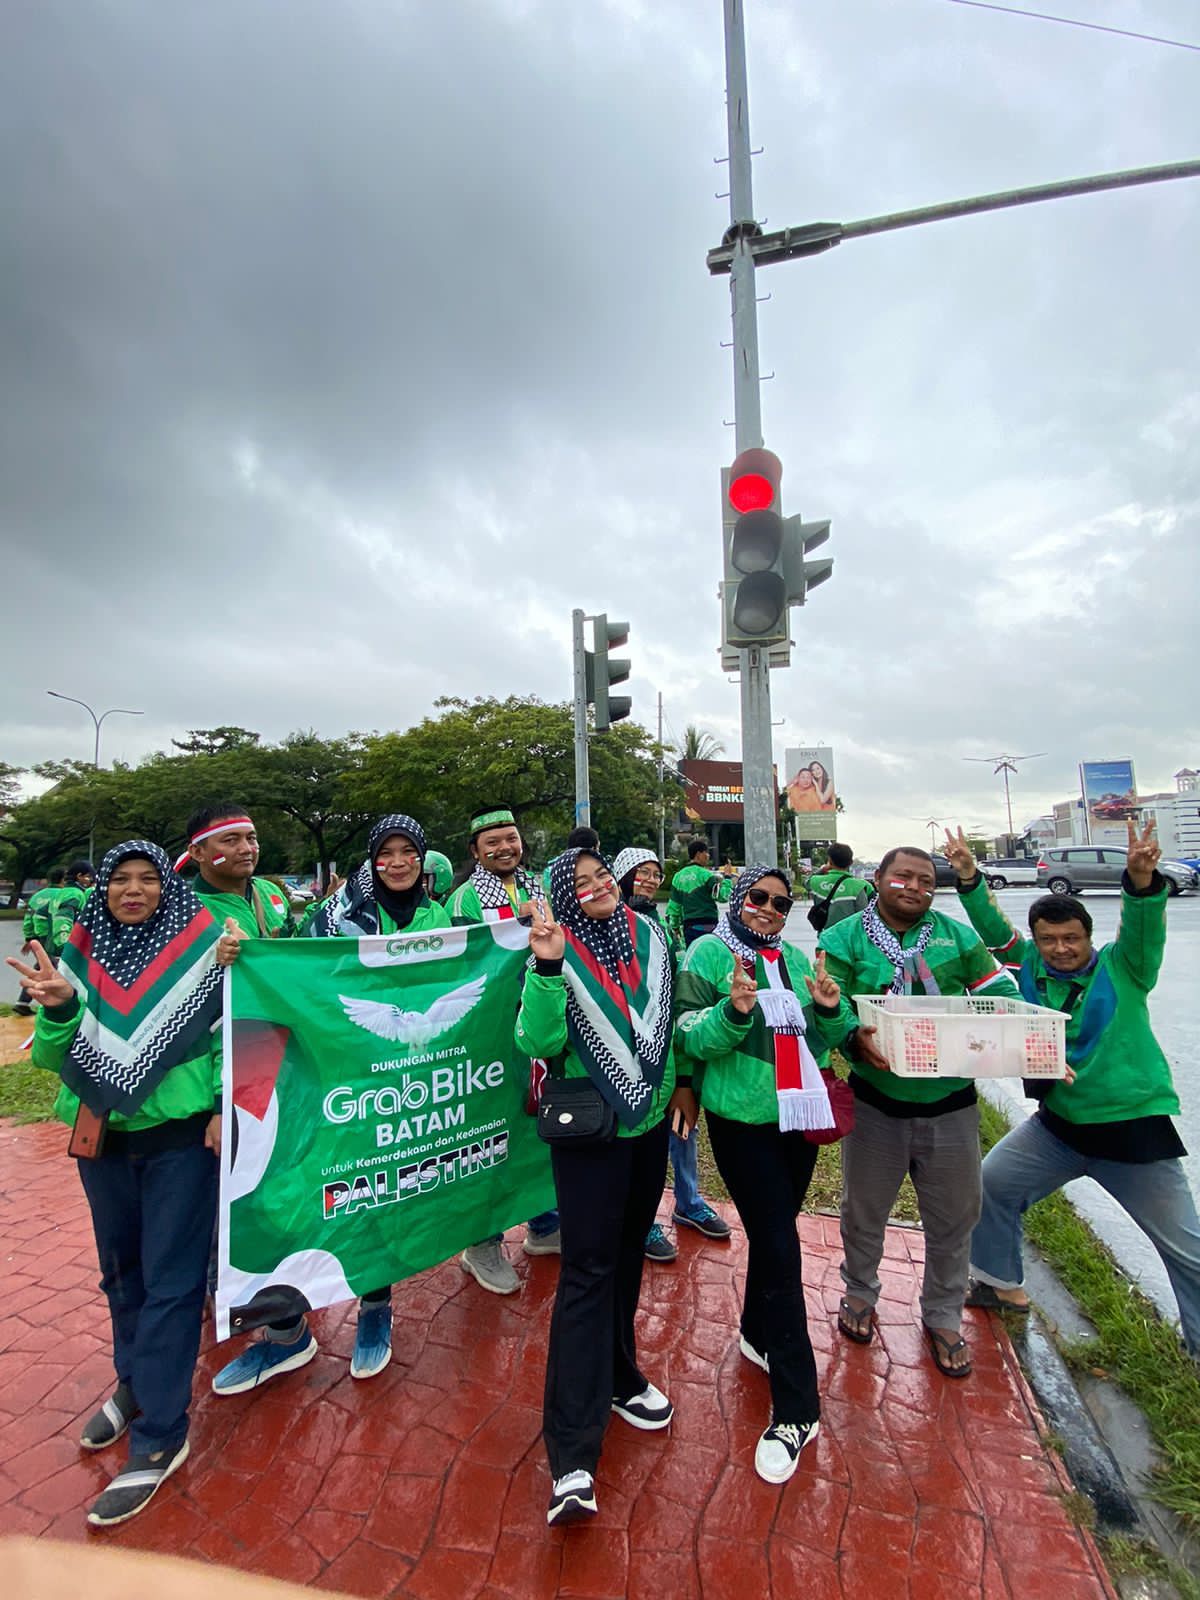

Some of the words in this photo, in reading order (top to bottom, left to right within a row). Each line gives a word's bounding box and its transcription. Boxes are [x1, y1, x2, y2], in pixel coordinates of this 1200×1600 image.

[386, 935, 444, 957] Grab
[371, 1052, 434, 1073] DUKUNGAN
[436, 1045, 467, 1061] MITRA
[321, 1160, 354, 1177] untuk
[356, 1141, 434, 1170] Kemerdekaan
[434, 1134, 456, 1149] dan
[456, 1117, 507, 1142] Kedamaian
[376, 1103, 466, 1148] BATAM
[322, 1130, 510, 1220] PALESTINE
